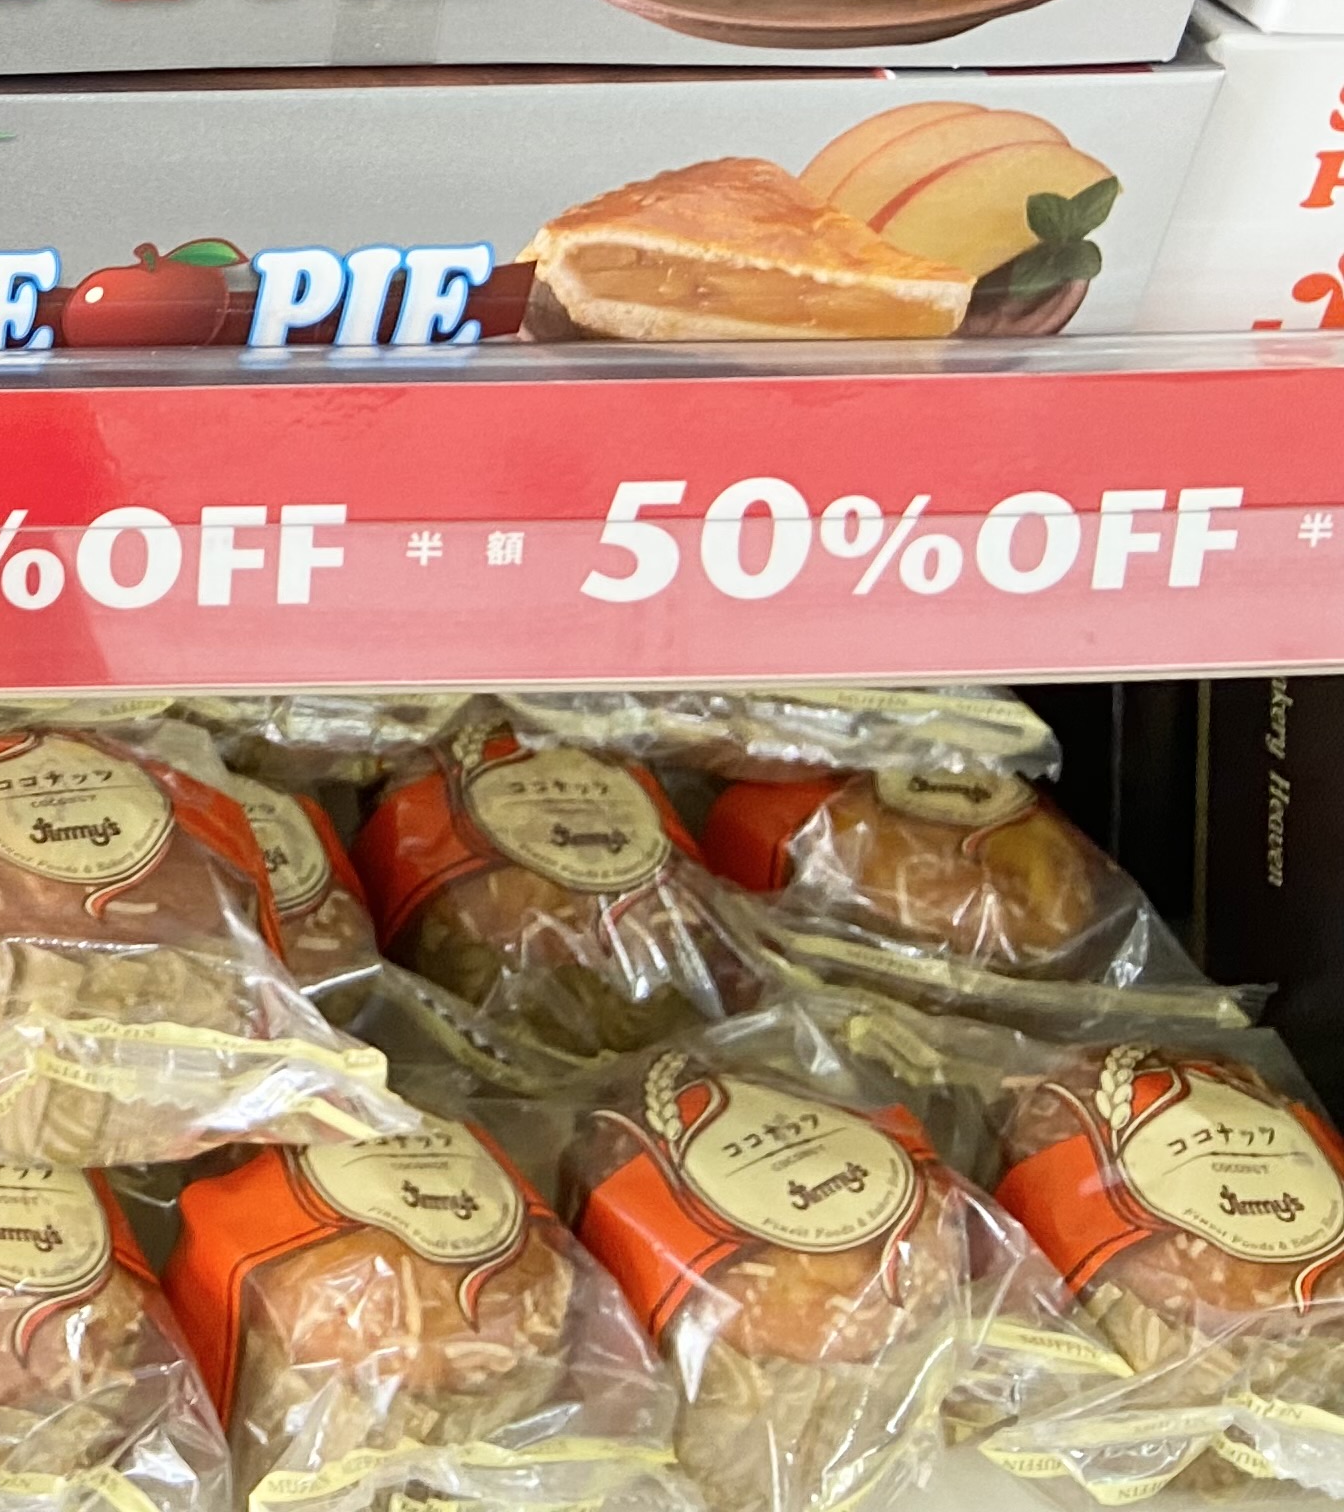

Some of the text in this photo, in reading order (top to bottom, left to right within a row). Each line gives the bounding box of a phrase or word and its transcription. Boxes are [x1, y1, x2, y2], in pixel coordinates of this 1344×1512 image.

[247, 241, 495, 347] PIE
[1298, 513, 1335, 548] 半
[1265, 678, 1293, 887] akery Heaven
[29, 816, 121, 847] Jimmy's
[1167, 1122, 1275, 1156] ココナッツ
[788, 1161, 870, 1211] Jimmy's
[1219, 1184, 1305, 1223] Jimmy's
